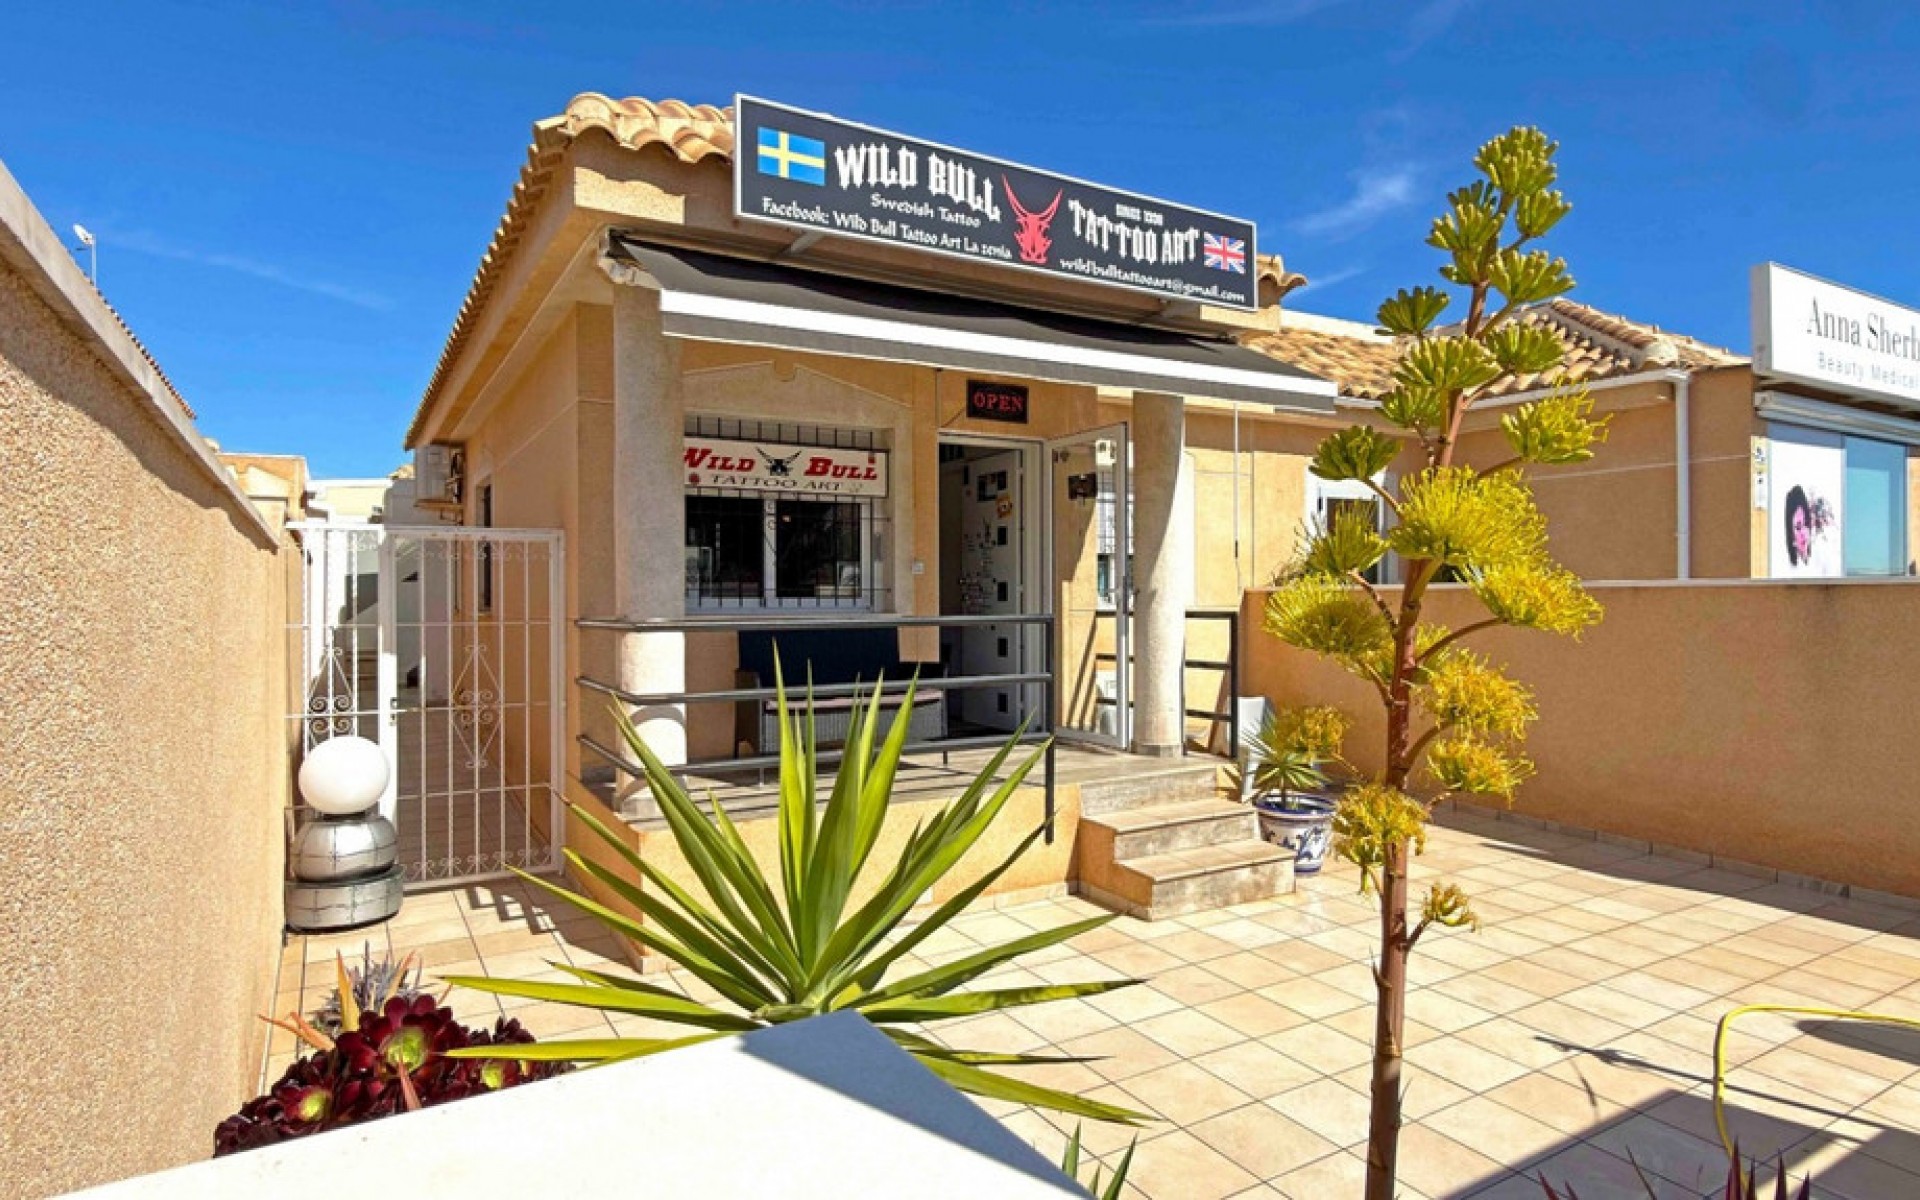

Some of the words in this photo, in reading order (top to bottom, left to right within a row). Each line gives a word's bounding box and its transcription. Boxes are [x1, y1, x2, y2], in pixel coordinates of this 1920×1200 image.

[834, 142, 918, 190] WILD
[928, 152, 1001, 223] BULL
[833, 210, 868, 232] Wild
[871, 217, 896, 237] Bull
[900, 223, 938, 245] Tattoo
[940, 233, 961, 249] Art
[964, 237, 979, 253] La
[870, 192, 934, 219] Swedish
[939, 206, 982, 229] Tattoo
[1068, 198, 1157, 265] TATTOO
[1162, 226, 1200, 265] ART
[1059, 257, 1245, 303] wildbulltattooart@gmail.com
[1806, 296, 1862, 347] Anna
[1818, 350, 1864, 382] Beauty
[973, 391, 1024, 412] OPEN
[710, 473, 798, 489] TATTOO
[803, 480, 843, 491] ART
